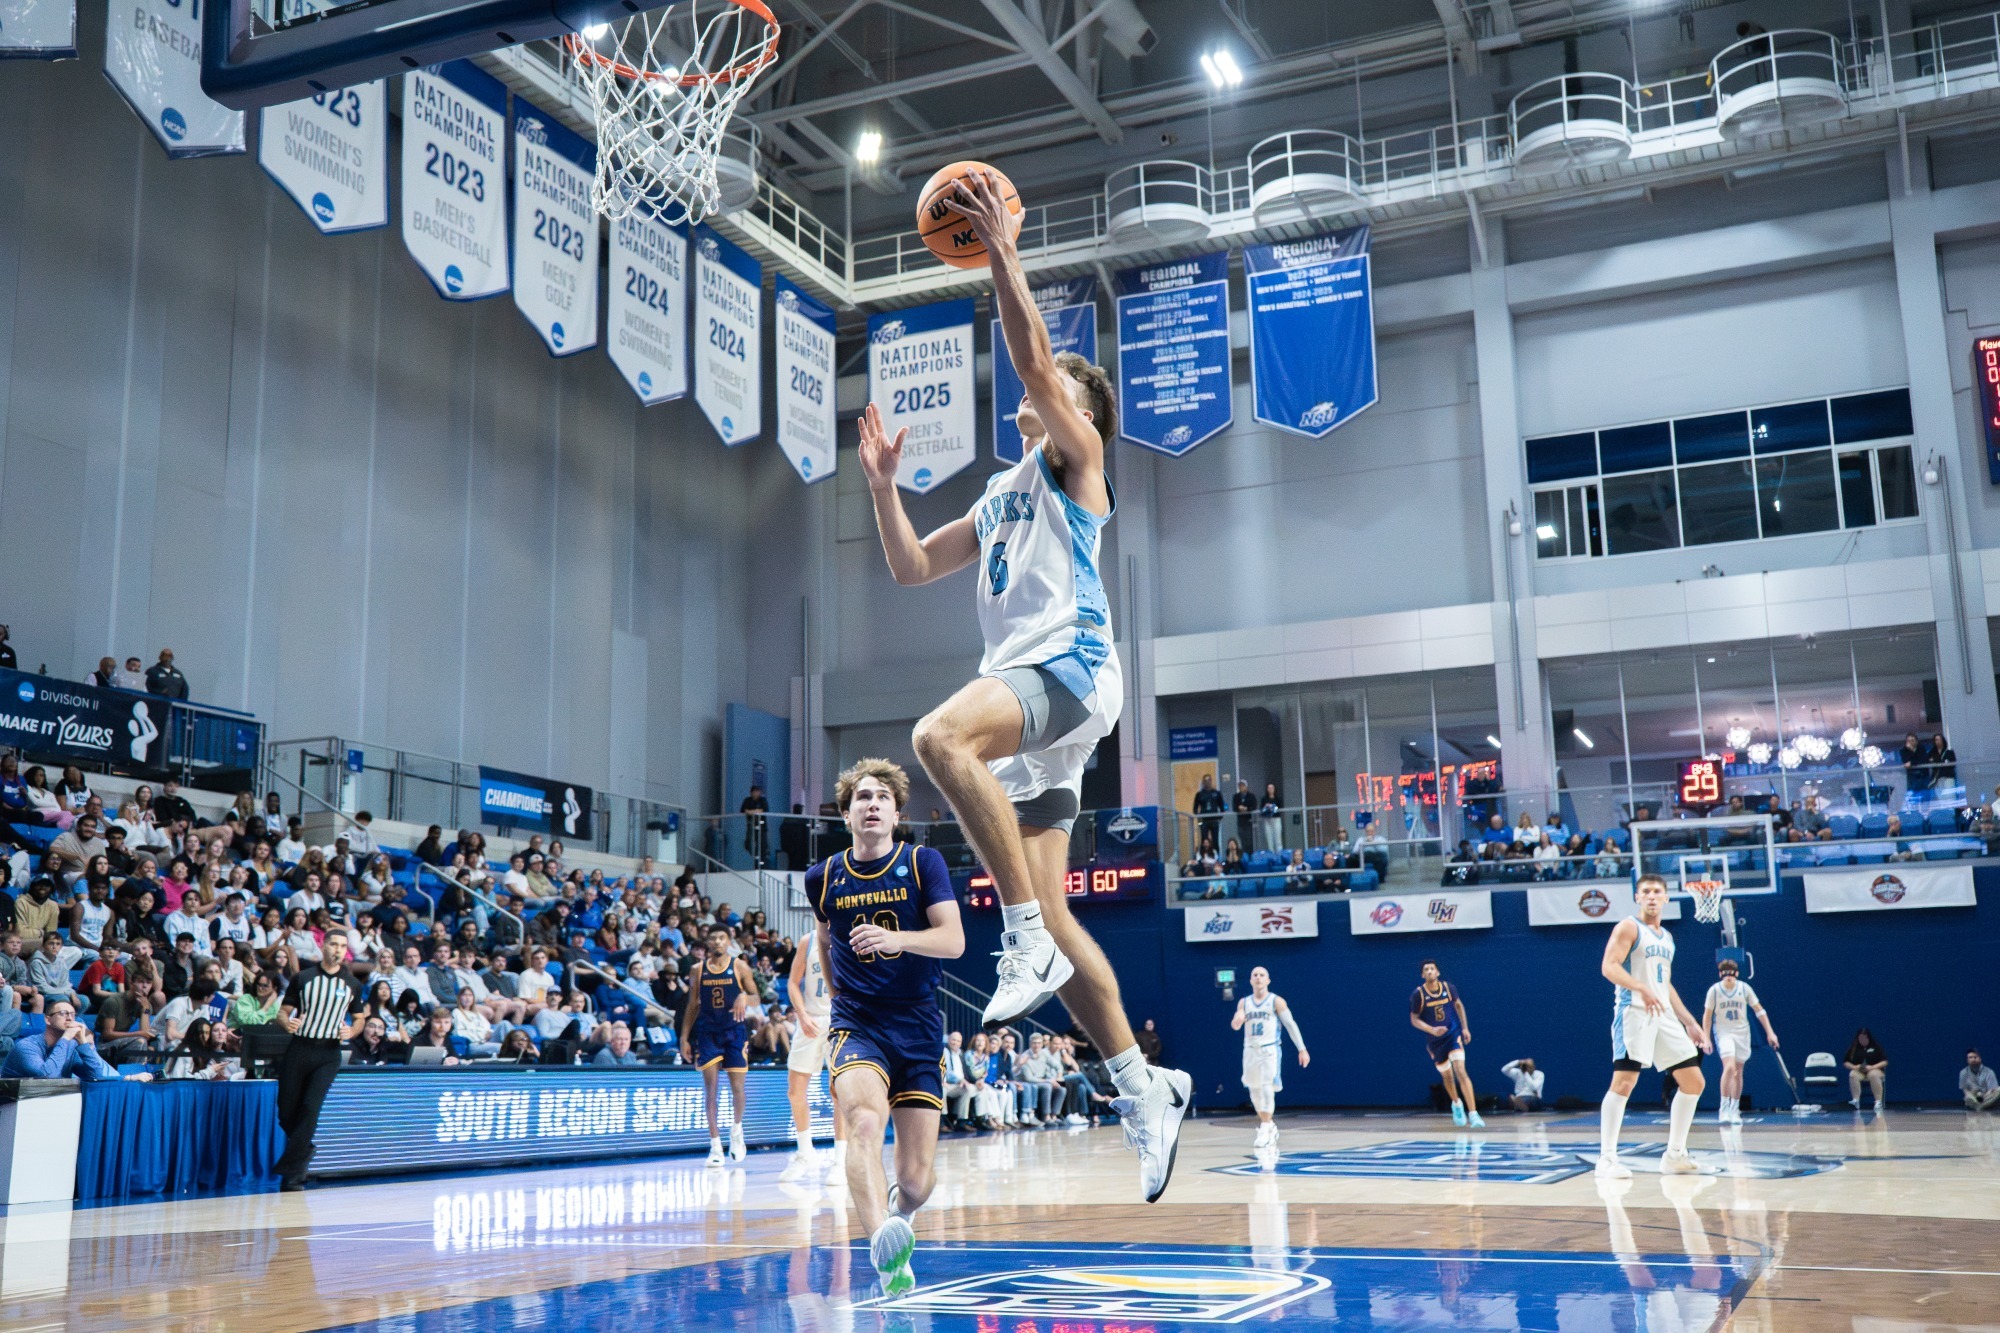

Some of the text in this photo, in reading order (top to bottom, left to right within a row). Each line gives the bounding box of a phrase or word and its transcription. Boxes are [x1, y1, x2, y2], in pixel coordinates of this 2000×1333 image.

[415, 76, 495, 143] NATIONAL
[288, 110, 363, 168] WOMEN'S
[414, 101, 495, 163] CHAMPIONS
[284, 134, 365, 196] SWIMMING
[425, 141, 485, 203] 2023
[525, 148, 593, 205] NATIONAL
[523, 171, 592, 224] CHAMPIONS
[435, 197, 476, 235] MEN'S
[413, 211, 492, 268] BASKETBALL
[534, 208, 584, 262] 2023
[619, 214, 680, 265] NATIONAL
[1273, 236, 1340, 259] REGIONAL
[618, 231, 680, 281] CHAMPIONS
[1140, 262, 1201, 283] REGIONAL
[1282, 251, 1332, 267] CHAMPIONS
[542, 260, 577, 294] MEN'S
[626, 265, 669, 316] 2024
[703, 265, 754, 313] NATIONAL
[1149, 276, 1194, 291] CHAMPIONS
[545, 285, 571, 311] GOLF
[702, 284, 755, 329] CHAMPIONS
[709, 317, 745, 362] 2024
[783, 316, 829, 359] NATIONAL
[872, 325, 906, 345] NSU
[880, 337, 963, 366] NATIONAL
[783, 335, 829, 373] CHAMPIONS
[880, 354, 963, 381] CHAMPIONS
[790, 365, 823, 405] 2025
[894, 382, 951, 414] 2025
[1299, 407, 1338, 427] NSU
[979, 491, 1035, 540] ARKS
[41, 690, 100, 710] DIVISION II
[0, 713, 113, 746] MAKE IT YOURS
[485, 788, 543, 814] CHAMPIONS
[1684, 774, 1719, 801] 29
[836, 887, 908, 910] MONTEVALLO
[1093, 870, 1118, 891] 60
[1203, 919, 1234, 935] NSU
[1657, 963, 1663, 983] 1
[712, 987, 724, 1009] 2
[1252, 1022, 1264, 1036] 12
[436, 1090, 530, 1143] SOUTH
[536, 1088, 627, 1138] REGION
